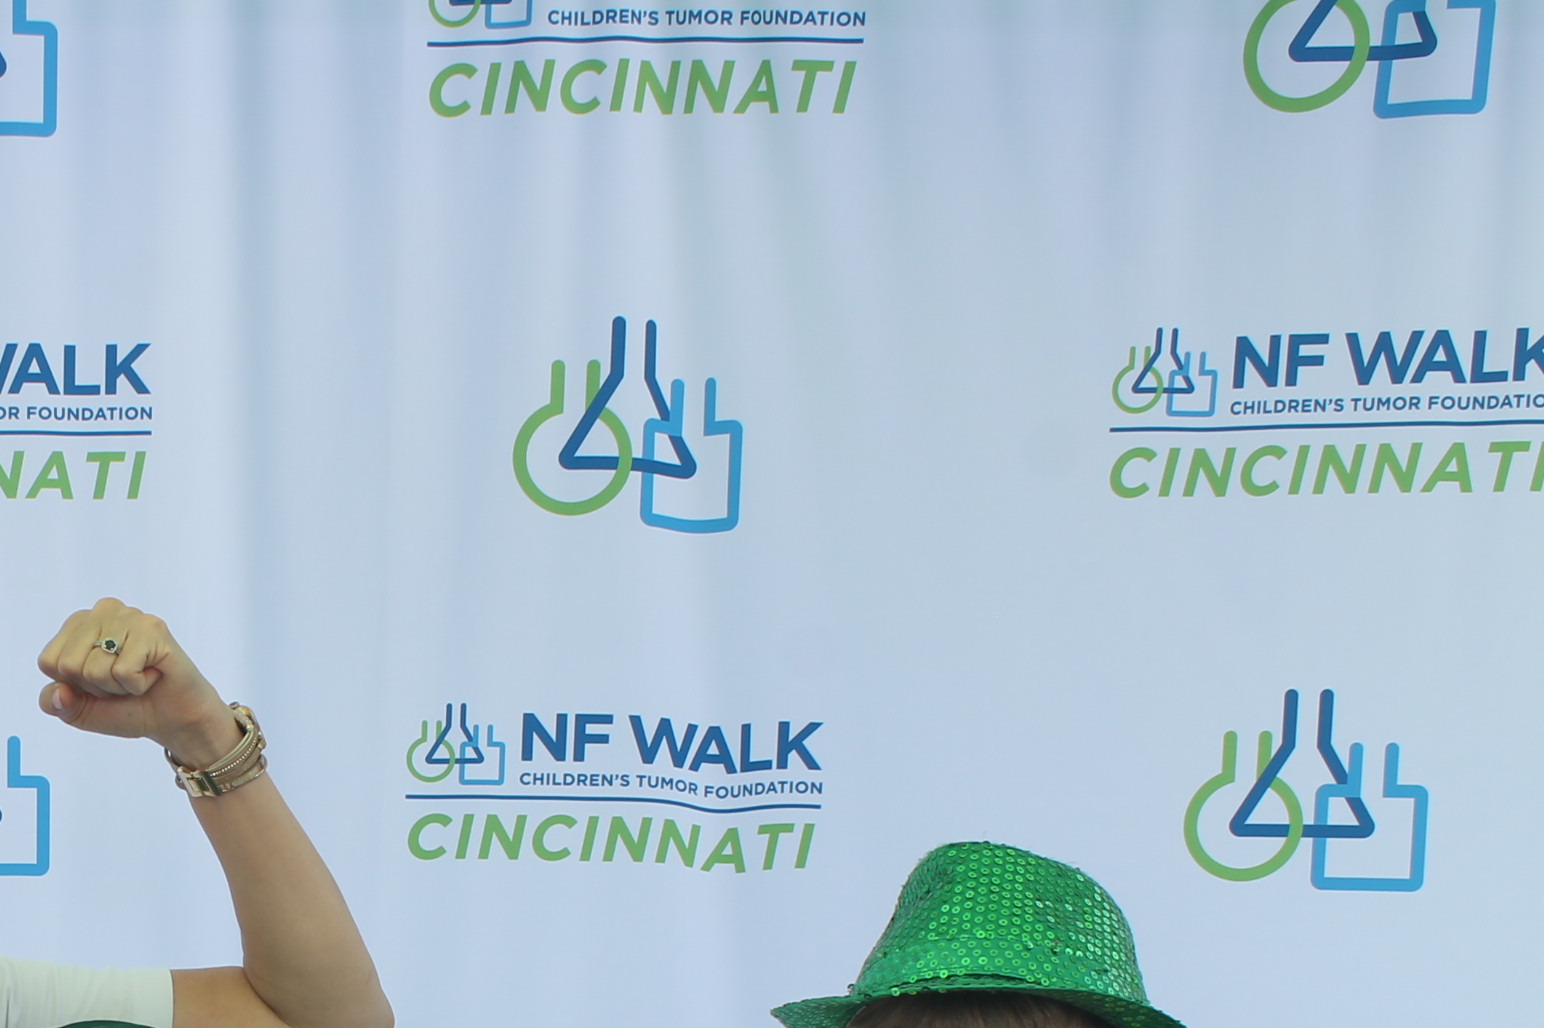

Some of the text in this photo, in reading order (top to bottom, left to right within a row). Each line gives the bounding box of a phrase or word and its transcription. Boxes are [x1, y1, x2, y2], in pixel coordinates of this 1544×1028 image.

[548, 9, 866, 26] CHILDREN'S TUMOR FOUNDATION
[430, 58, 857, 117] CINCINNATI
[1233, 328, 1544, 388] NF WALK
[27, 406, 152, 420] FOUNDATION
[1230, 398, 1344, 415] CHILDREN'S
[1351, 396, 1421, 411] TUMOR
[522, 713, 823, 774] NF WALK
[520, 773, 822, 799] CHILDREN'S TUMOR FOUNDATION
[408, 814, 815, 873] CINCINNATI
